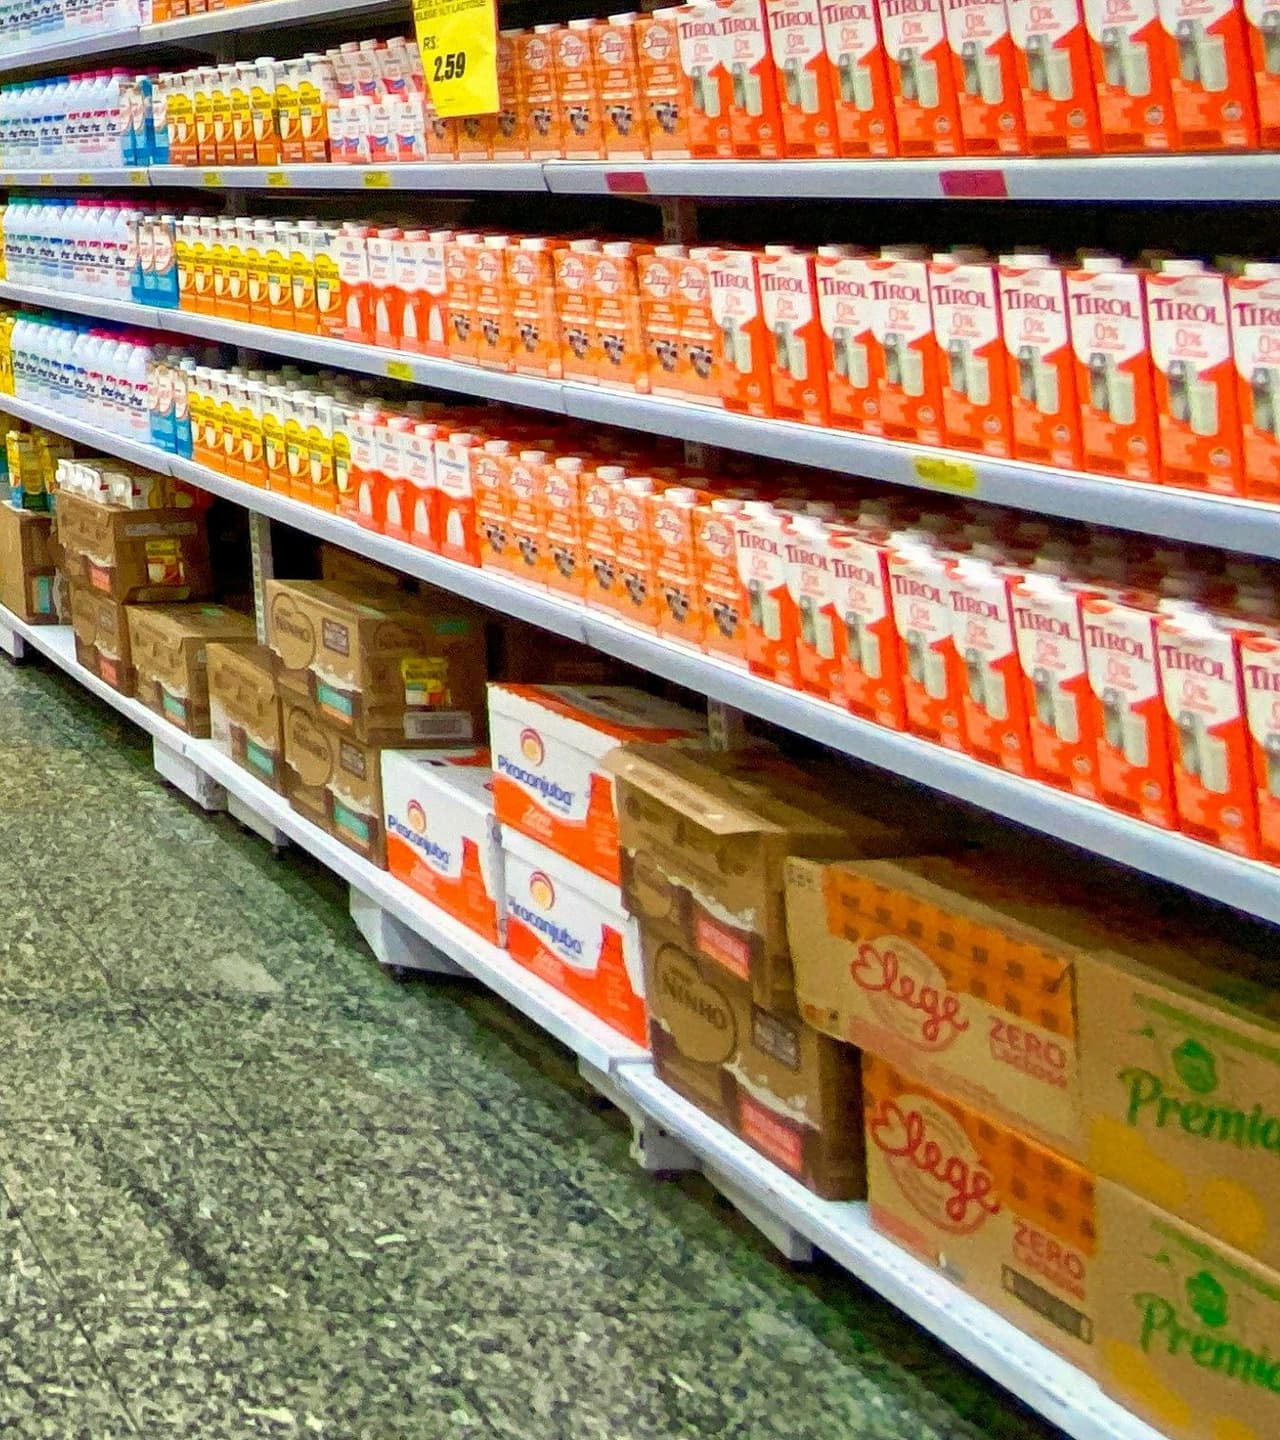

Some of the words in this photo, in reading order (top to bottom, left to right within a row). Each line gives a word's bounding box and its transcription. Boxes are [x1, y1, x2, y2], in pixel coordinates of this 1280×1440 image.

[681, 20, 719, 39] TIROL
[720, 16, 761, 35] TIROL
[770, 11, 818, 30] TIROL
[823, 4, 871, 24] TIROL
[433, 52, 466, 82] 2,59
[1071, 293, 1140, 320] TIROL
[1150, 298, 1225, 325] TIROL
[1014, 608, 1080, 641] TIROL
[1086, 625, 1152, 662] TIROL
[1160, 644, 1234, 683] TIROL
[497, 755, 574, 806] Piracanjuba
[387, 814, 451, 866] Piracanjuba
[508, 897, 585, 956] Piracanjuba
[988, 1015, 1067, 1070] ZERO
